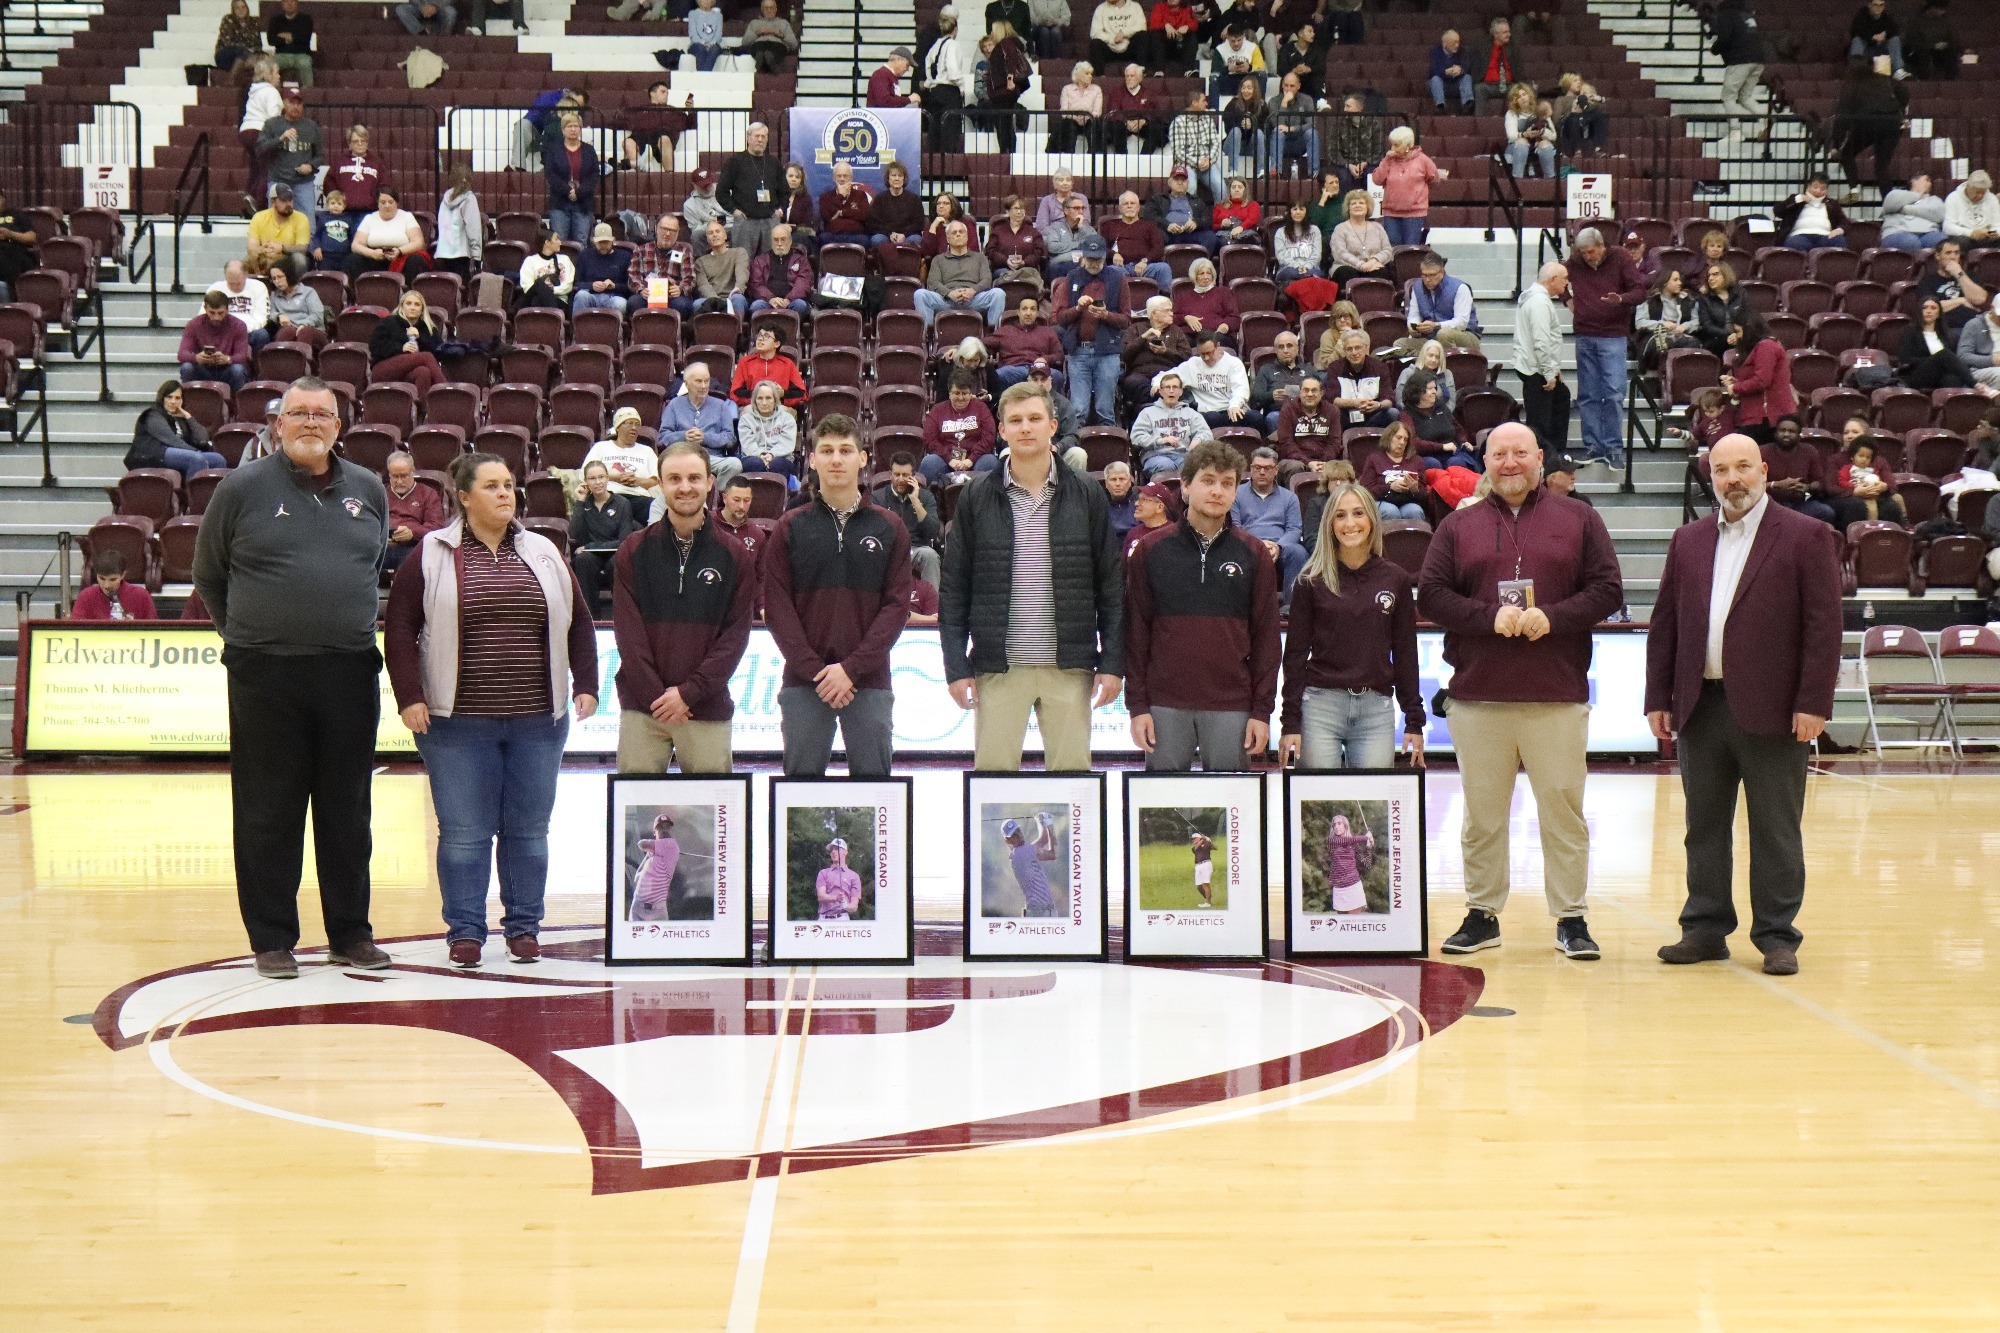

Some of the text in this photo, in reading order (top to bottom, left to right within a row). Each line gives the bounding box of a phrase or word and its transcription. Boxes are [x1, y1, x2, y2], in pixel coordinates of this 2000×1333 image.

[838, 111, 868, 122] DIVISION
[839, 128, 872, 153] 50
[856, 154, 877, 164] YOURS
[95, 191, 118, 207] 103
[1579, 201, 1600, 217] 105
[1295, 423, 1330, 436] Old Navy
[629, 456, 645, 464] STATE
[44, 637, 225, 668] Edward Jone
[44, 683, 181, 694] Thomas M. Kliethermes
[43, 716, 150, 726] Phone: 304-363-7300
[150, 731, 230, 744] www.edwardj
[1391, 800, 1401, 842] SKYLER
[718, 805, 727, 863] MATTHEW
[878, 806, 887, 888] COLE TEGANO
[1230, 806, 1240, 885] CADEN MOORE
[1073, 803, 1082, 927] JOHN LOGAN TAYLOR
[1392, 845, 1402, 909] JEFAIRJIAN
[718, 866, 727, 915] BARRISH
[1177, 918, 1225, 926] ATHLETICS
[1339, 923, 1387, 932] ATHLETICS
[662, 930, 710, 939] ATHLETICS
[824, 929, 872, 939] ATHLETICS
[1018, 926, 1066, 935] ATHLETICS
